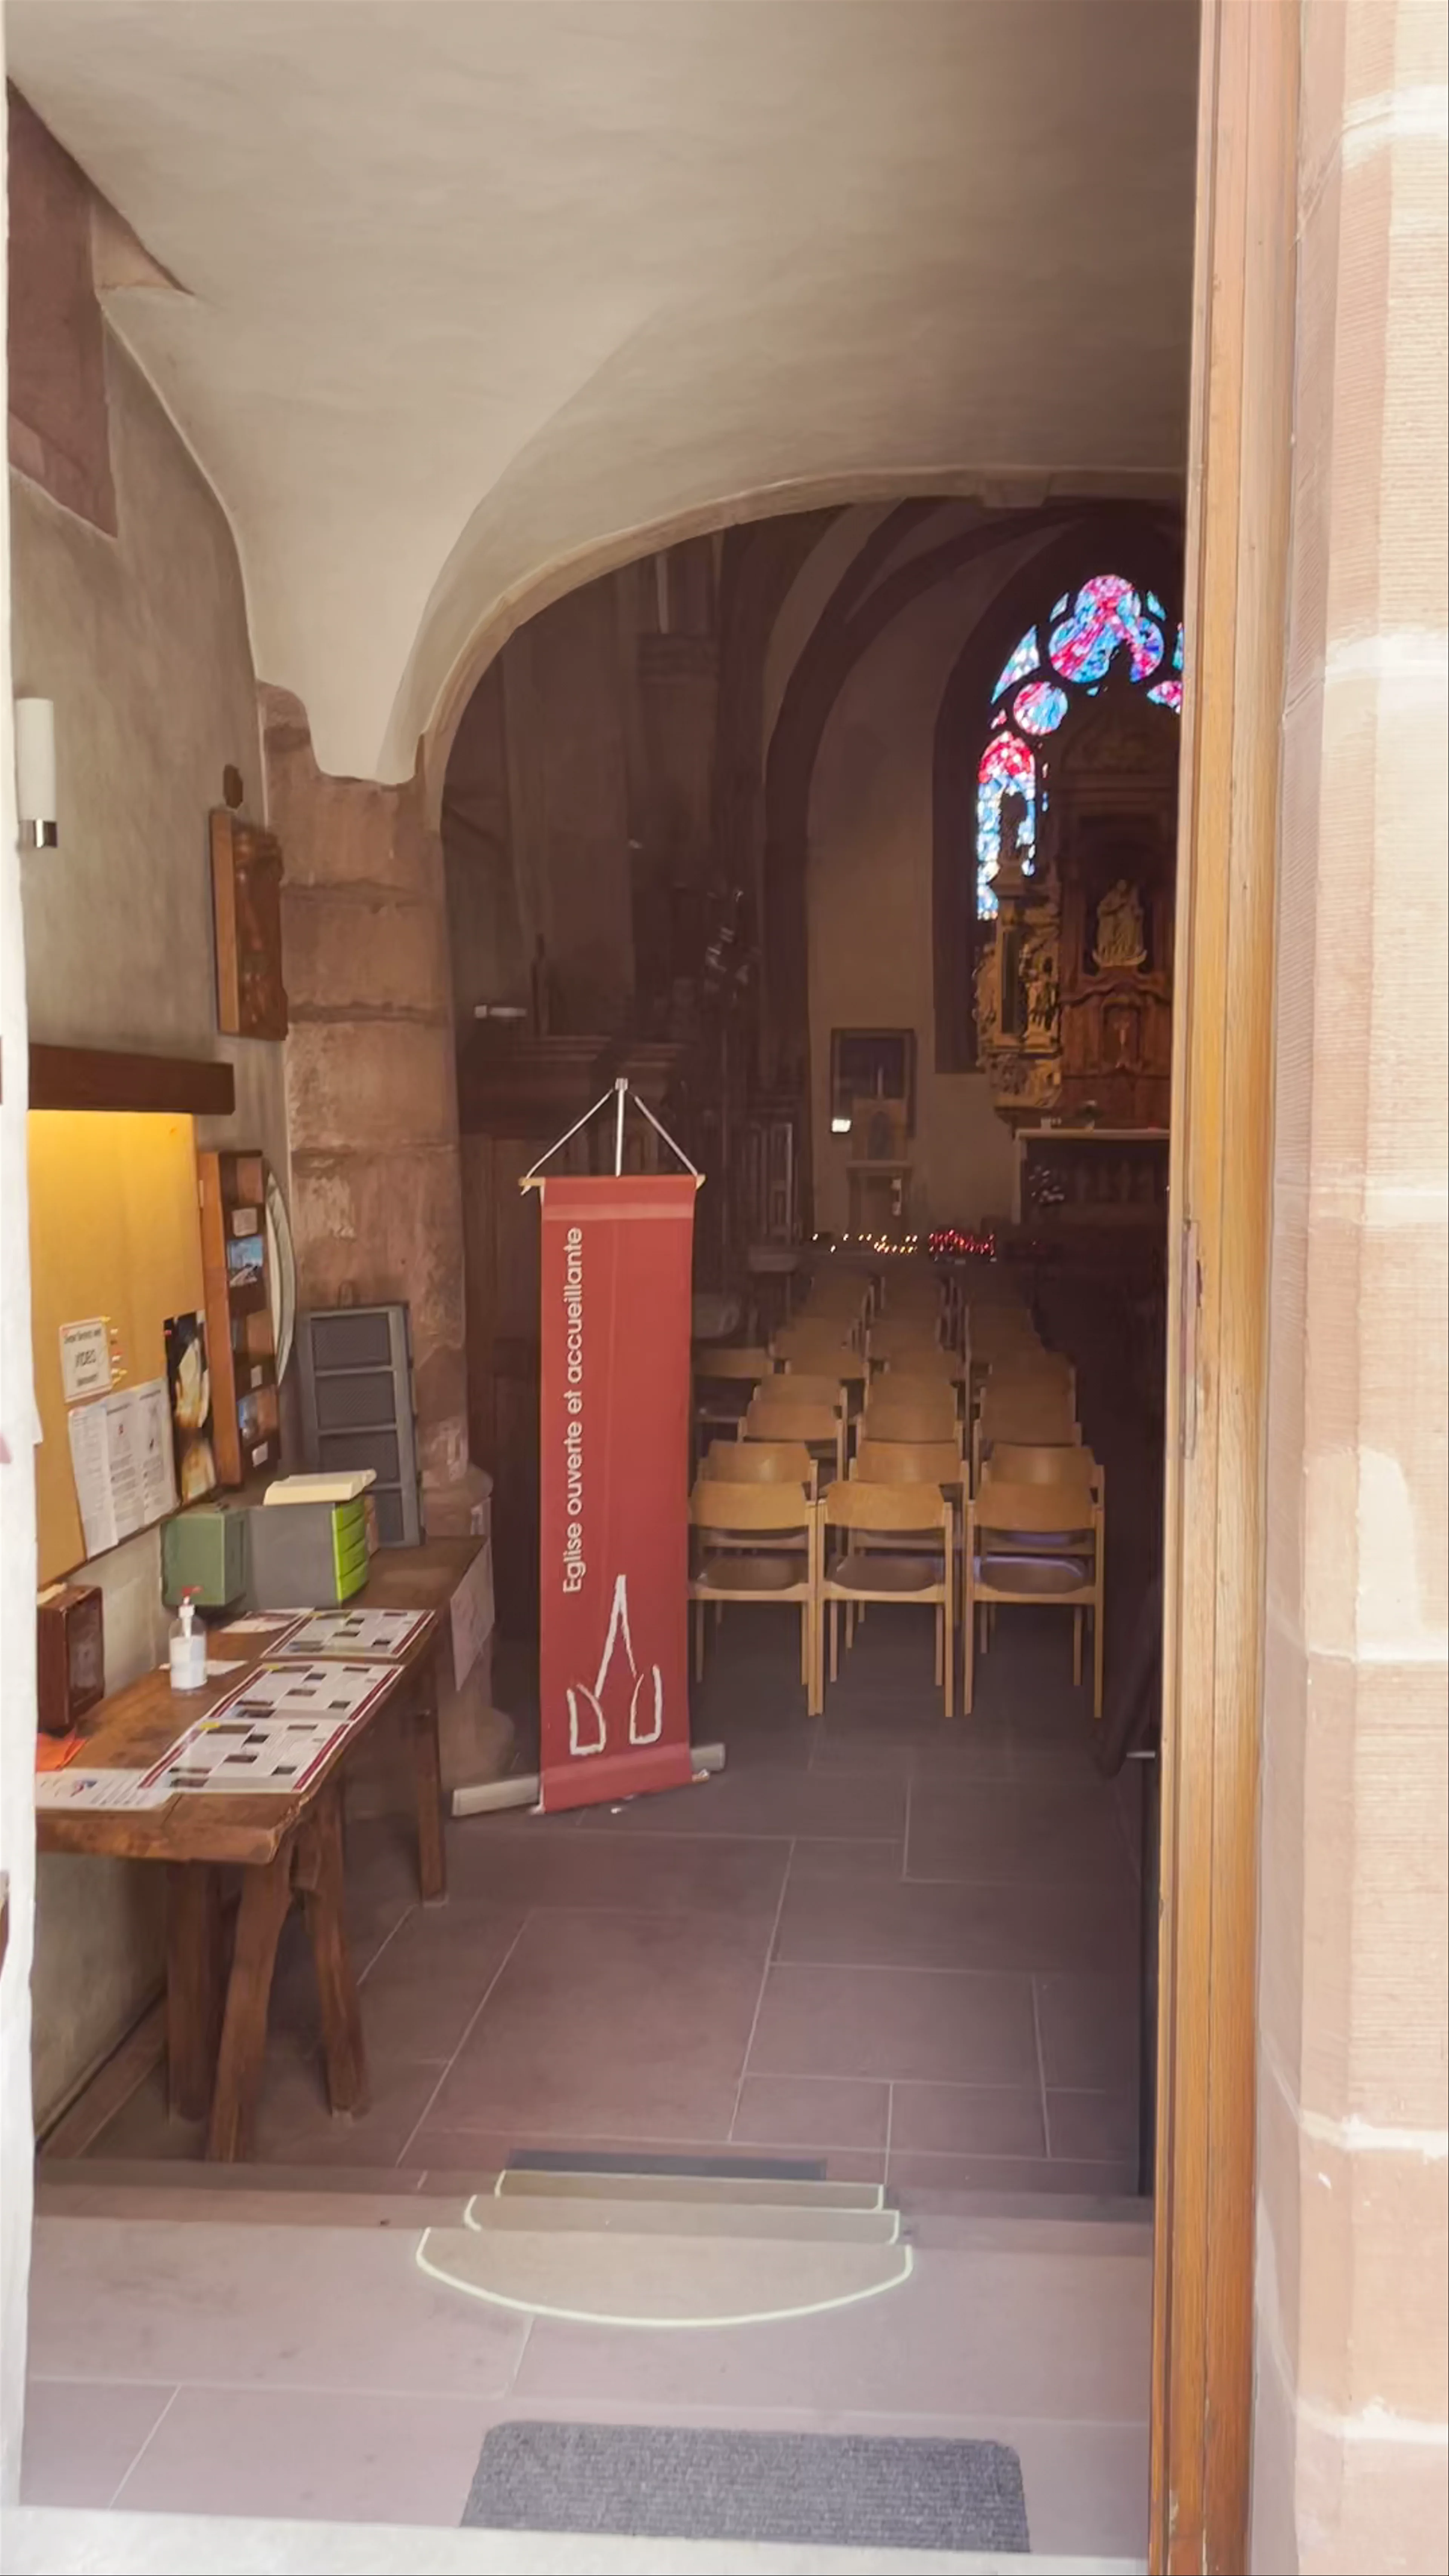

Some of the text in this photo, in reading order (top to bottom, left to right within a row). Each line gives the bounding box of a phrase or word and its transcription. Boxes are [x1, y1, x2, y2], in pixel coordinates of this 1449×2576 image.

[563, 1227, 586, 1592] Eglise ouverte et accueillante
